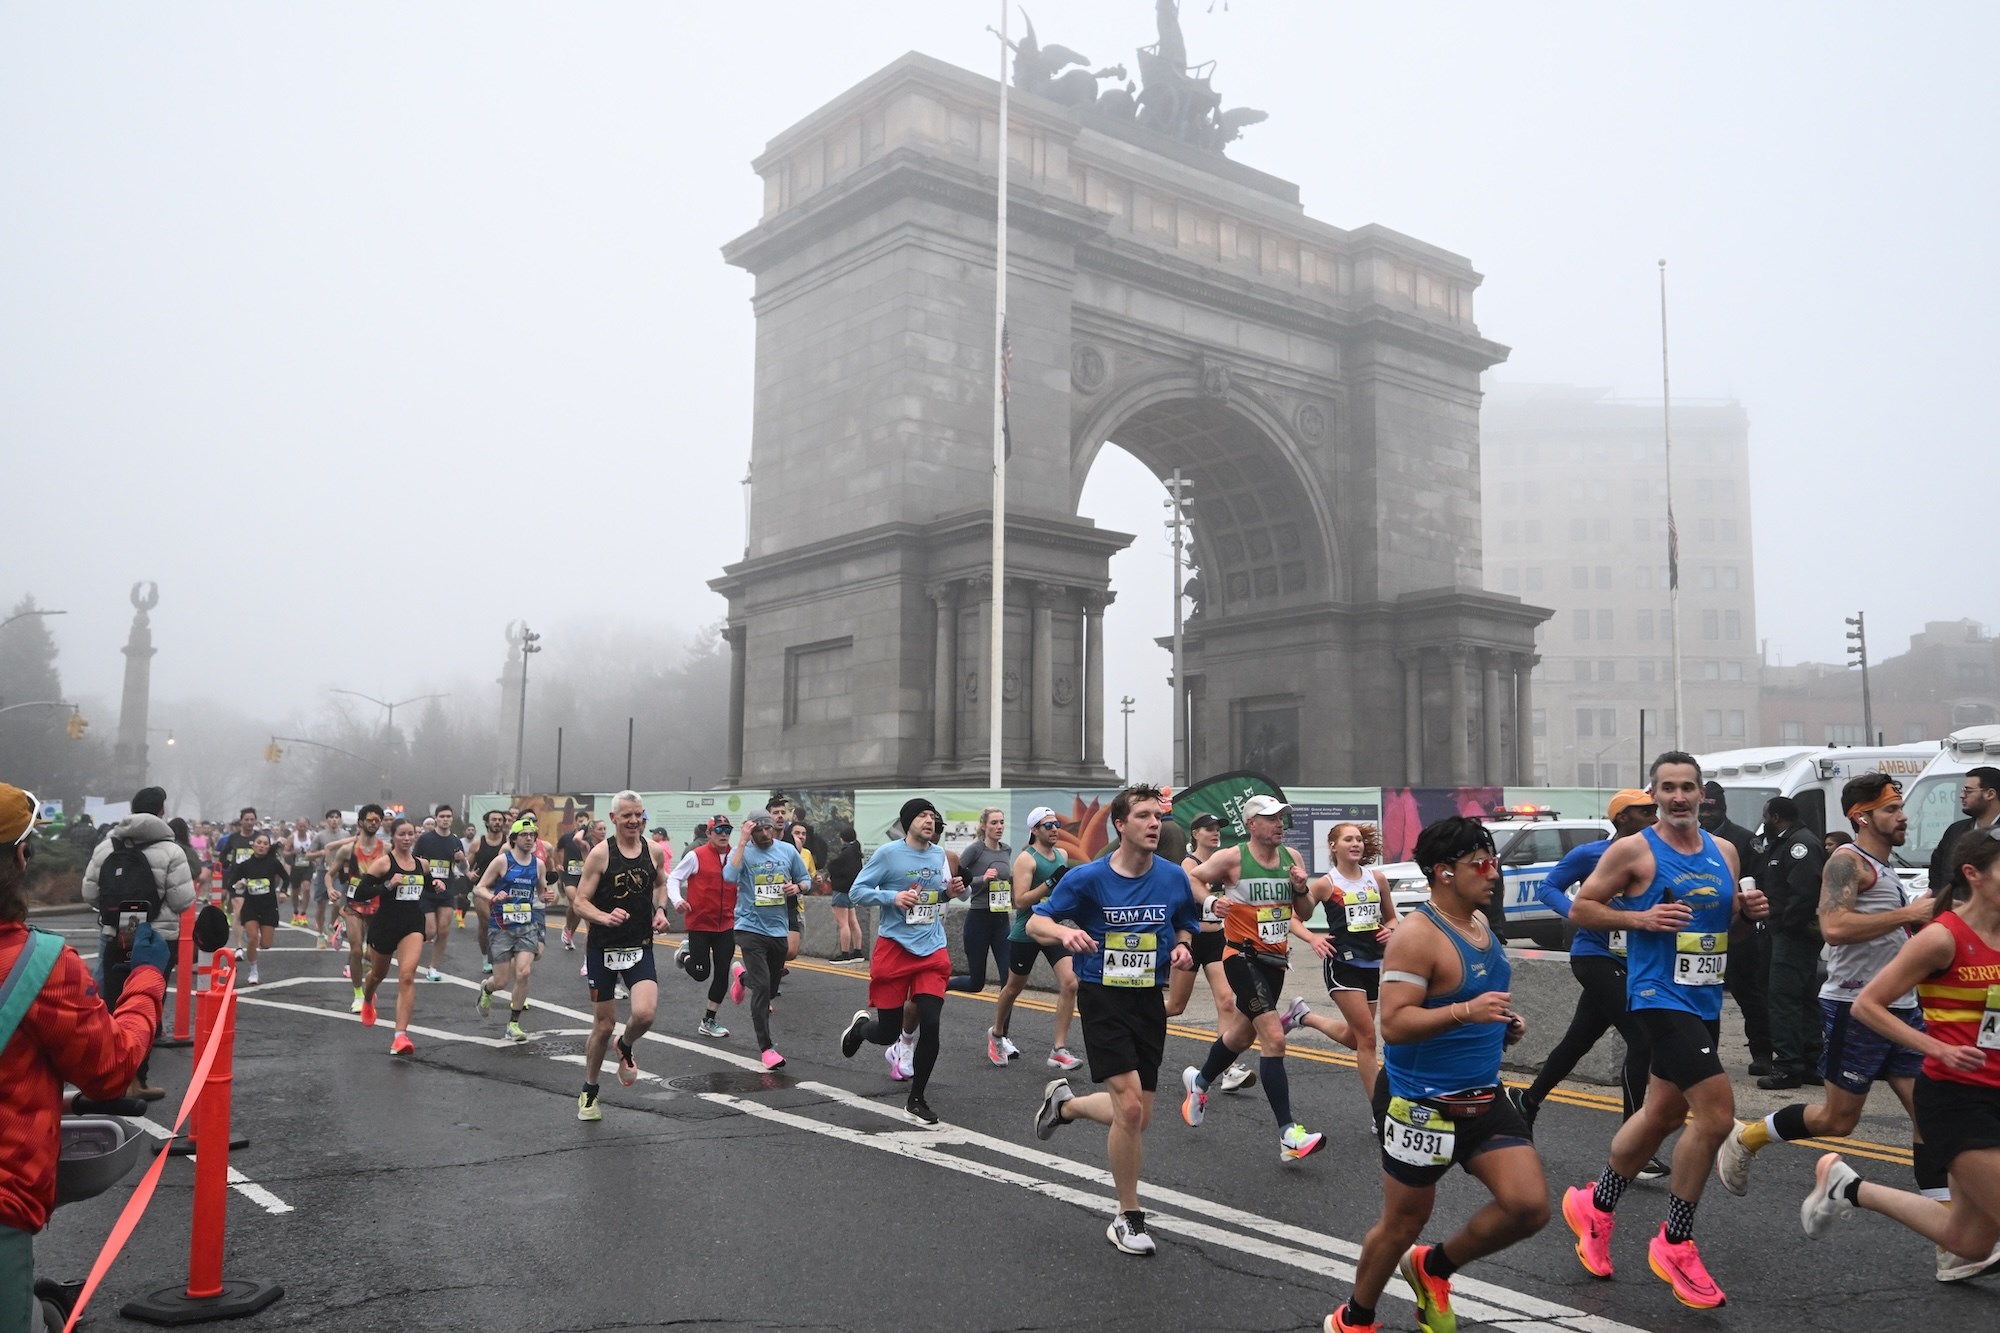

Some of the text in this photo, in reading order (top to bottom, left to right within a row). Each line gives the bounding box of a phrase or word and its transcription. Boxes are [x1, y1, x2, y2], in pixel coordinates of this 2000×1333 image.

[511, 889, 530, 897] RUNNER
[766, 885, 780, 895] 1752
[991, 893, 996, 901] B
[908, 908, 915, 916] A
[1104, 908, 1166, 923] TEAM ALS
[1349, 904, 1376, 917] E 2973
[1262, 922, 1288, 935] A 1306
[1613, 931, 1621, 940] A
[617, 952, 637, 963] 7783
[1106, 953, 1150, 968] A 6874
[1680, 957, 1722, 974] B 2510
[1982, 1016, 1995, 1033] A
[1411, 1110, 1428, 1120] NYC
[1386, 1123, 1443, 1155] A 5931
